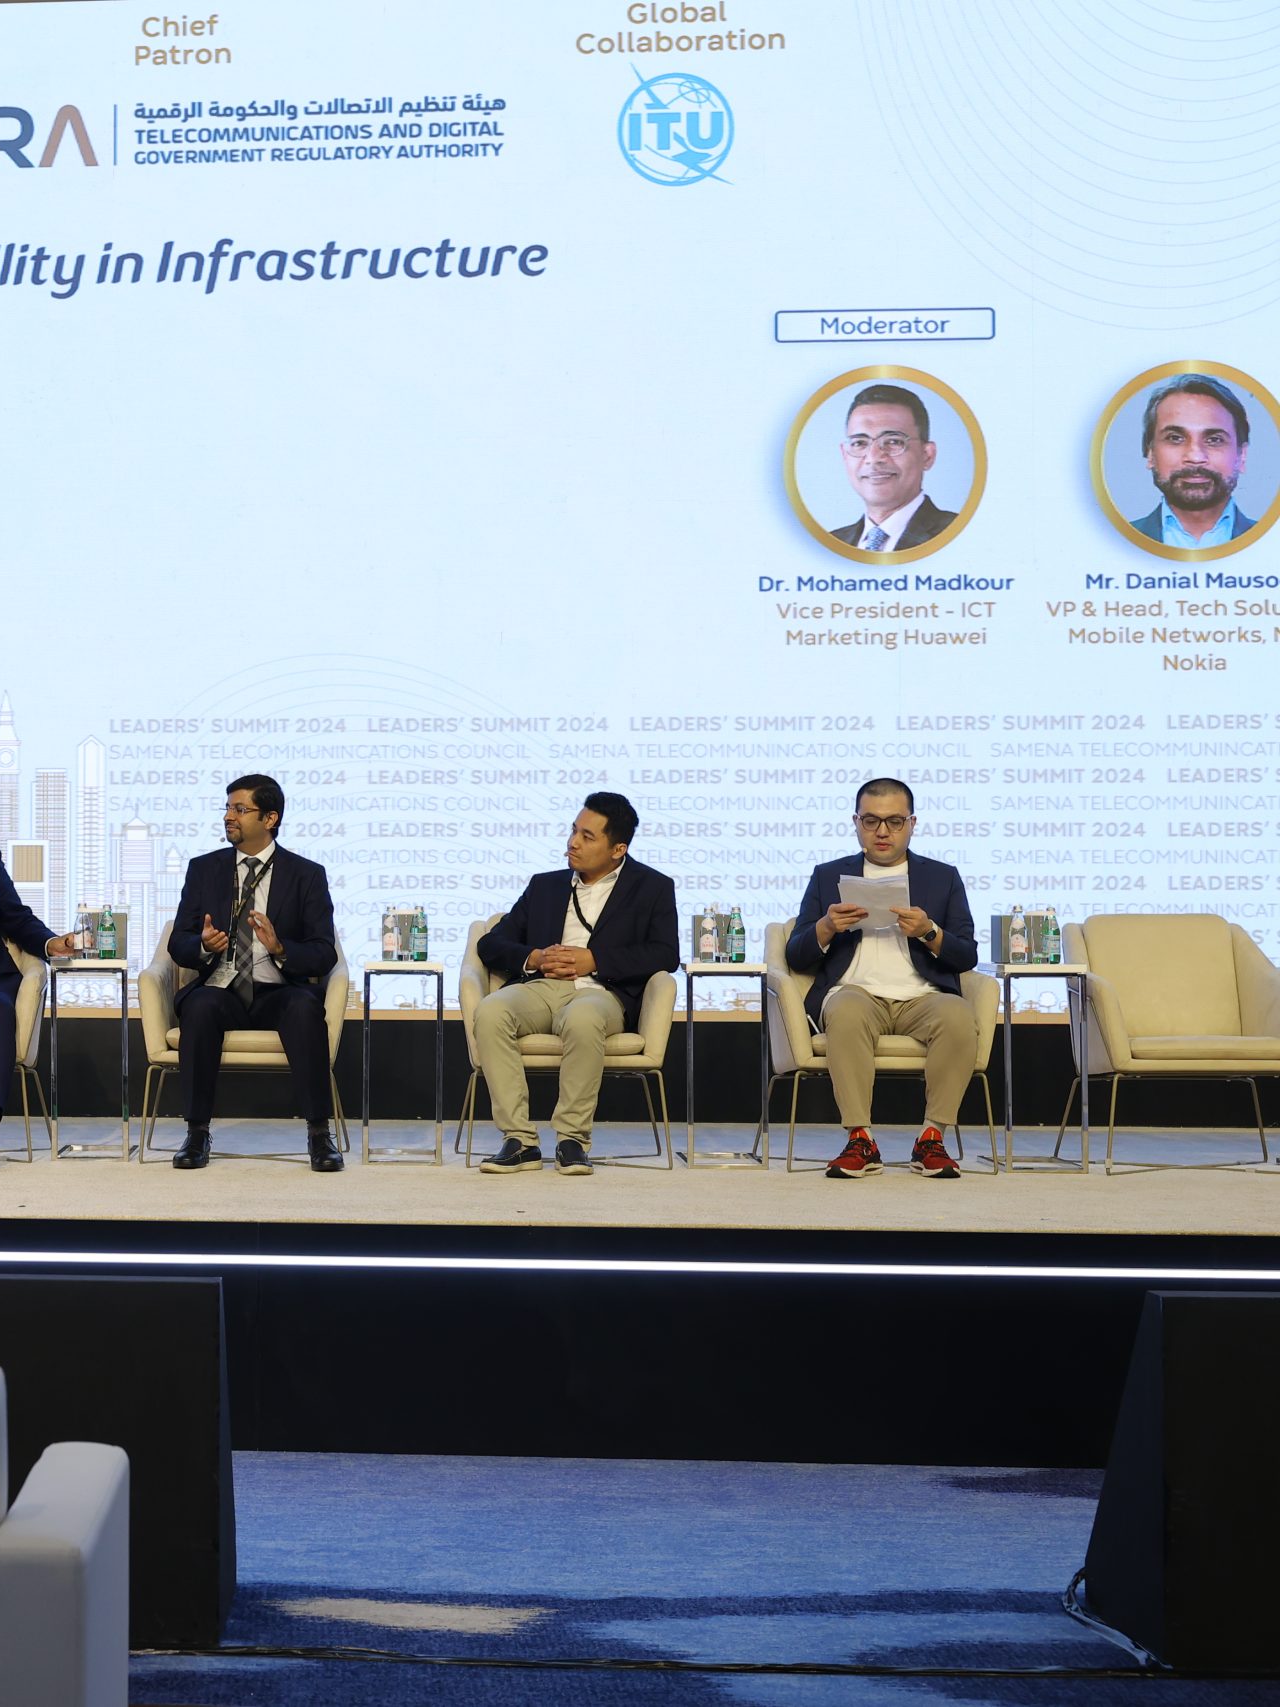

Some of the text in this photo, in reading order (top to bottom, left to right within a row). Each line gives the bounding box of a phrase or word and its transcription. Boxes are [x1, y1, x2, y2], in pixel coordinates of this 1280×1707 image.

[627, 1, 727, 24] Global
[142, 14, 218, 37] Chief
[576, 29, 785, 54] Collaboration
[135, 45, 231, 66] Patron
[134, 93, 506, 123] هيئة تنظيم الاتصالات والحكومة الرقمية
[135, 121, 504, 145] TELECOMMUNICATIONS AND DIGITAL
[629, 110, 724, 151] ITU
[135, 142, 504, 165] GOVERNMENT REGULATORY AUTHORITY
[96, 243, 143, 284] in
[157, 238, 548, 295] Infrastructure
[820, 316, 950, 336] Moderator
[759, 574, 1015, 592] Dr. Mohamed Madkour
[1086, 571, 1280, 589] Mr. Danial Mauso
[776, 602, 824, 619] Vice
[831, 601, 939, 619] President
[962, 602, 997, 618] ICT
[1046, 601, 1076, 617] VP
[1082, 601, 1096, 617] &
[1104, 600, 1168, 618] Head,
[1175, 600, 1227, 616] Tech
[786, 627, 987, 650] Marketing Huawei
[1069, 627, 1145, 644] Mobile
[1152, 626, 1266, 644] Networks,
[1163, 653, 1227, 671] Nokia
[109, 718, 347, 733] LEADERS' SUMMIT 2024
[368, 717, 608, 732] LEADERS' SUMMIT 2024
[629, 716, 874, 731] LEADERS' SUMMIT 2024
[896, 715, 1146, 730] LEADERS' SUMMIT 2024
[1167, 715, 1269, 729] LEADERS'
[109, 744, 192, 759] SAMENA
[444, 744, 531, 759] COUNCIL
[549, 743, 630, 758] SAMENA
[882, 743, 972, 758] COUNCIL
[990, 742, 1073, 757] SAMENA
[109, 770, 205, 785] LEADERS'
[295, 770, 347, 785] 2024
[368, 769, 608, 784] LEADERS' SUMMIT 2024
[629, 769, 727, 784] LEADERS'
[734, 769, 816, 784] SUMMIT
[1003, 768, 1085, 783] SUMMIT
[1091, 768, 1146, 783] 2024
[1167, 768, 1269, 783] LEADERS'
[444, 796, 531, 811] COUNCIL
[990, 796, 1073, 811] SAMENA
[295, 822, 347, 837] 2024
[368, 822, 464, 837] LEADERS'
[471, 822, 551, 837] SUMMIT
[634, 822, 727, 837] EADERS'
[734, 822, 816, 837] SUMMIT
[1003, 822, 1086, 837] SUMMIT
[1092, 822, 1147, 837] 2024
[1168, 822, 1269, 837] LEADERS'
[444, 849, 531, 864] COUNCIL
[991, 849, 1074, 864] SAMENA
[368, 875, 464, 890] LEADERS'
[1003, 875, 1086, 890] SUMMIT
[1092, 875, 1147, 890] 2024
[1169, 876, 1270, 891] LEADERS'
